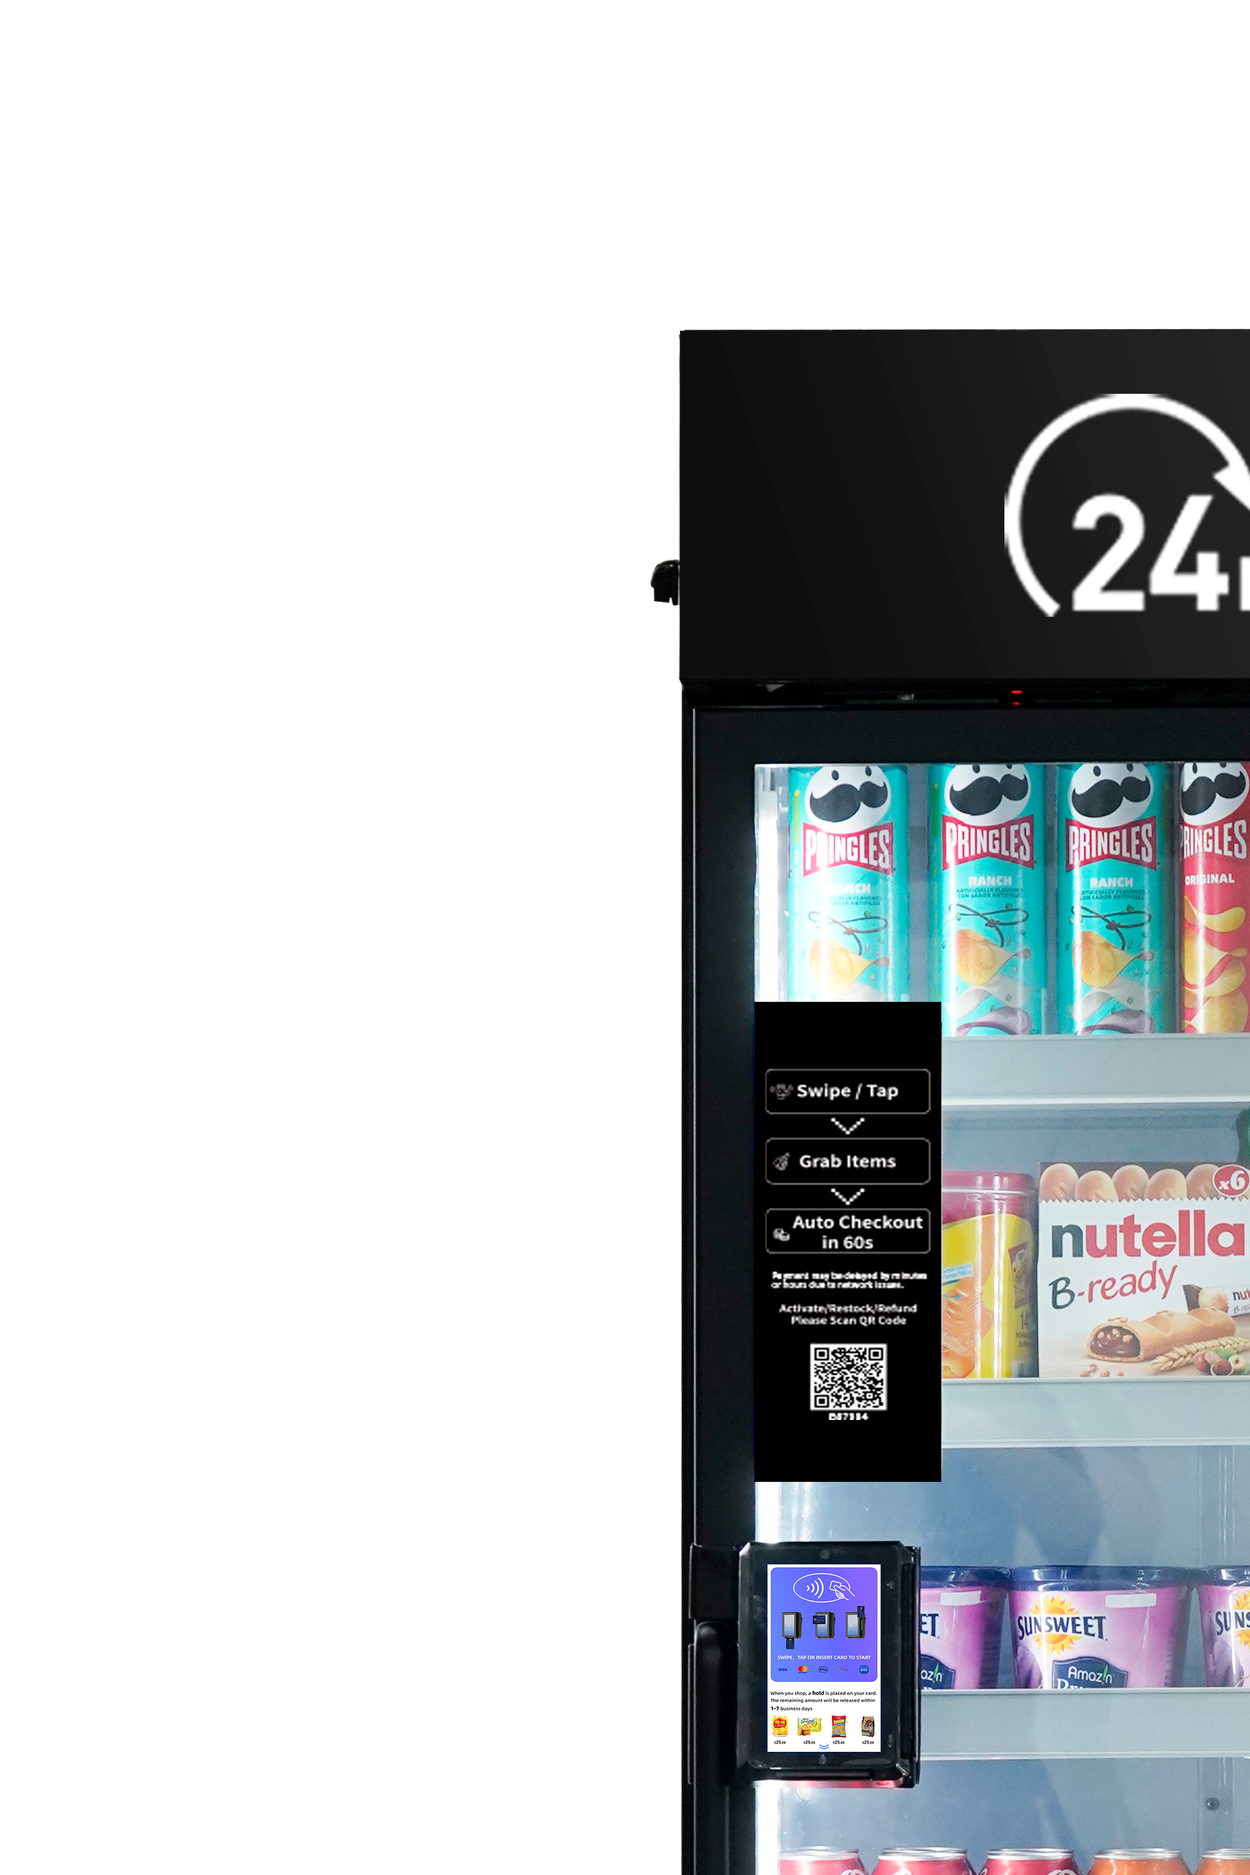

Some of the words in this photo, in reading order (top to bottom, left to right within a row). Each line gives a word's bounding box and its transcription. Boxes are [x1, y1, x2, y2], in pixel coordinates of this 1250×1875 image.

[945, 821, 1031, 864] PRINGLES
[1068, 823, 1153, 865] PRINGLES
[968, 876, 1012, 887] RANCH
[1089, 877, 1134, 888] RANCH
[1185, 873, 1235, 886] ORIGINAL
[797, 1083, 851, 1100] Swipe
[866, 1084, 899, 1100] Tap
[799, 1154, 842, 1168] Grab
[846, 1155, 896, 1168] Items
[1218, 1170, 1245, 1191] x6
[792, 1215, 834, 1229] Auto
[838, 1215, 923, 1229] Checkout
[1051, 1209, 1245, 1258] nutella
[822, 1235, 839, 1249] in
[843, 1236, 874, 1249] 60s
[1049, 1260, 1178, 1310] B-ready
[790, 1316, 827, 1325] Please
[829, 1316, 857, 1325] Scan
[858, 1316, 876, 1326] QR
[878, 1316, 907, 1325] Code
[1017, 1615, 1107, 1641] SUNSWEET
